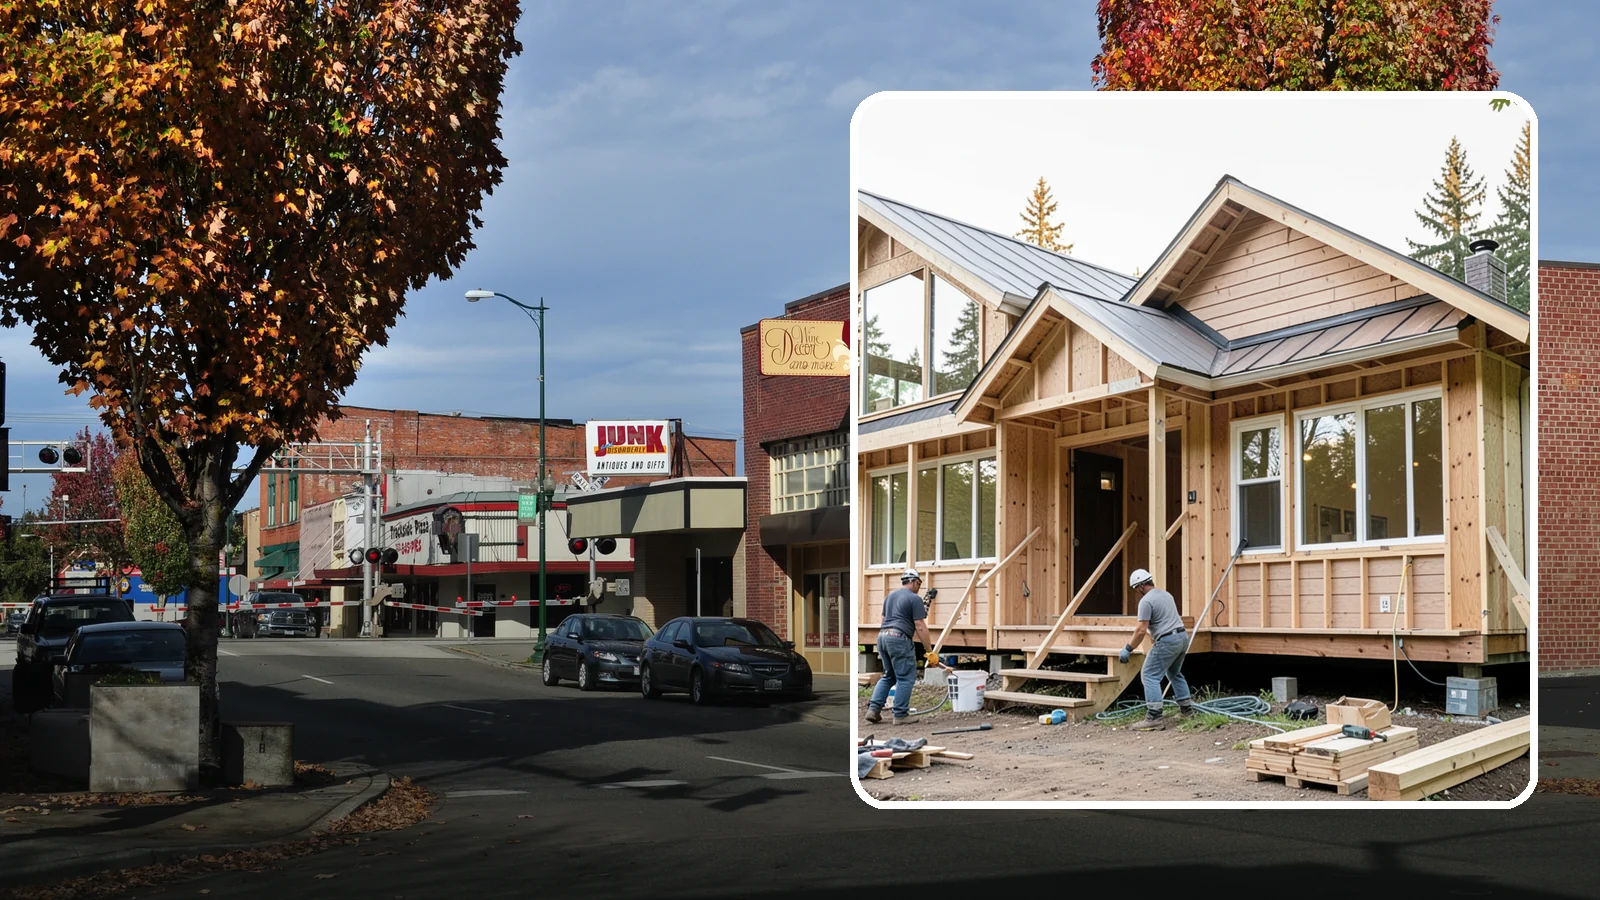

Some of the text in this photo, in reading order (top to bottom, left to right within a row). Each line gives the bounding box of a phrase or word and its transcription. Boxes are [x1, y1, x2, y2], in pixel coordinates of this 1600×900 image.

[595, 425, 665, 457] JUNK
[607, 446, 646, 454] DISORDERLY
[597, 461, 665, 470] ANTIQUES AND GIFTS
[414, 519, 429, 535] Pizza
